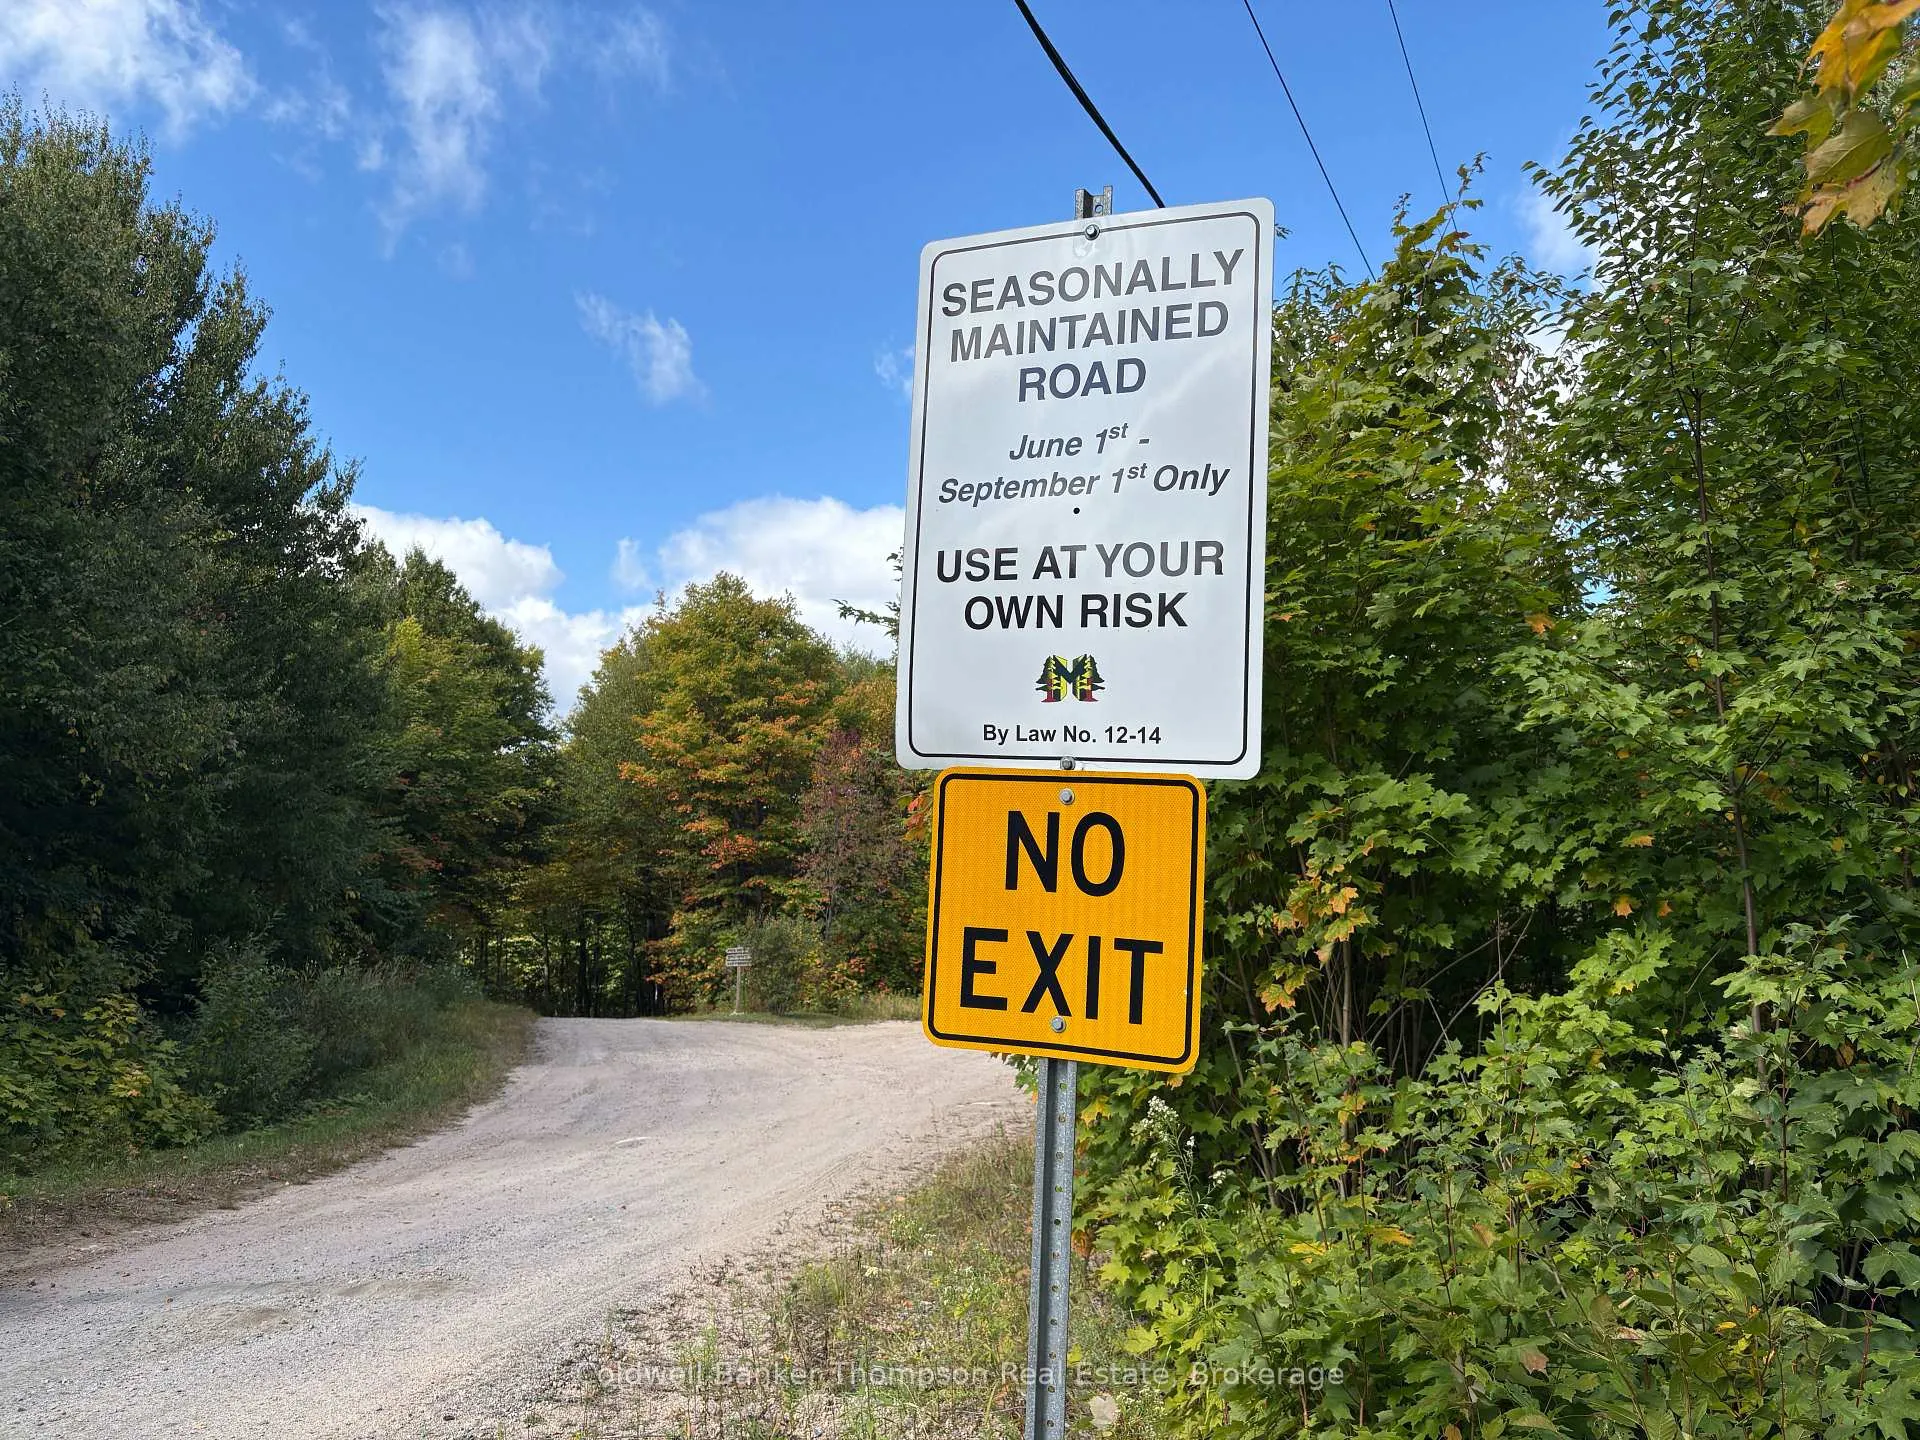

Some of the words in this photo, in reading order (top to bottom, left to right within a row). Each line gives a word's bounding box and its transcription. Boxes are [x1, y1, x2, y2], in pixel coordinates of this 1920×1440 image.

[942, 248, 1244, 317] SEASONALLY
[951, 300, 1229, 362] MAINTAINED
[1018, 357, 1147, 402] ROAD
[1009, 434, 1082, 461] June
[1095, 422, 1128, 455] 1st
[938, 471, 1101, 508] September
[1111, 462, 1147, 494] 1st
[1153, 463, 1231, 497] Only
[936, 546, 1018, 584] USE
[1031, 544, 1087, 580] AT
[1095, 540, 1225, 578] YOUR
[964, 594, 1063, 630] OWN
[1080, 592, 1188, 628] RISK
[982, 724, 1009, 746] By
[1015, 725, 1056, 743] Law
[1063, 725, 1097, 744] No.
[1104, 726, 1162, 745] 12-14
[1005, 810, 1126, 897] NO
[960, 926, 1164, 1025] EXIT
